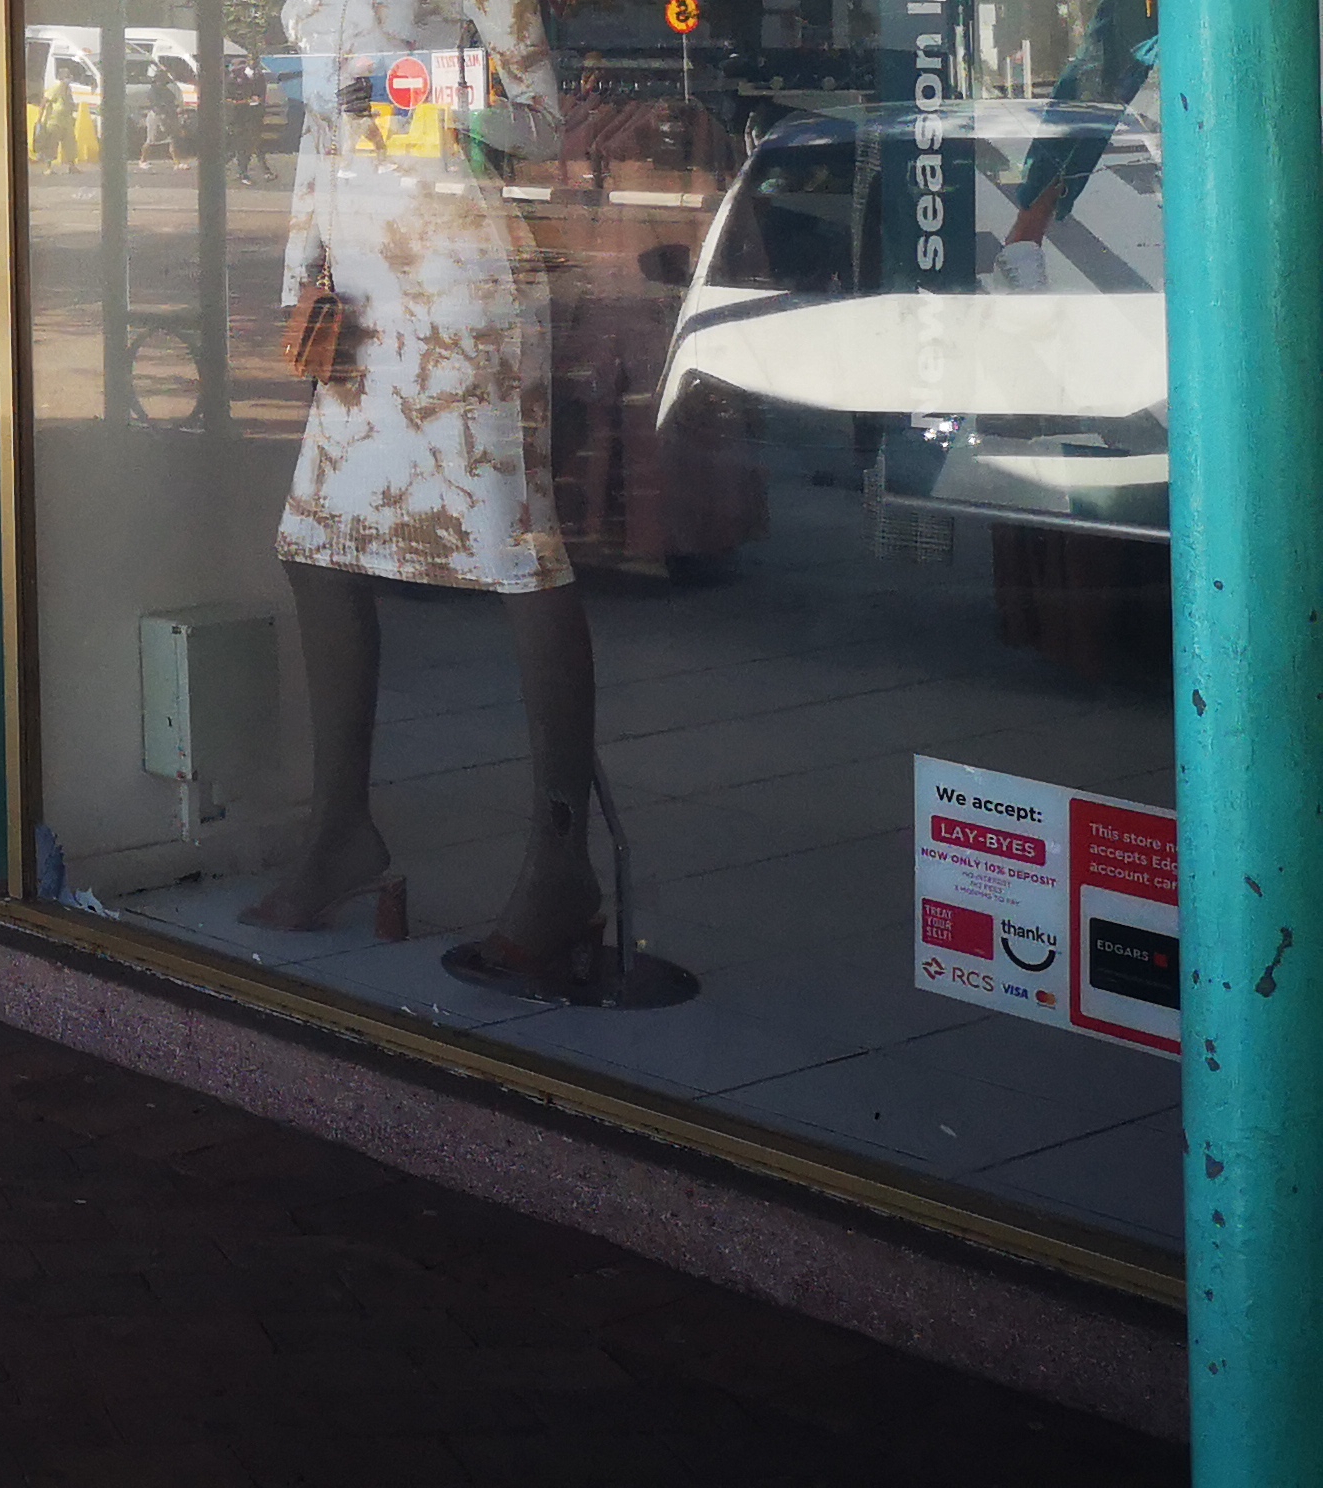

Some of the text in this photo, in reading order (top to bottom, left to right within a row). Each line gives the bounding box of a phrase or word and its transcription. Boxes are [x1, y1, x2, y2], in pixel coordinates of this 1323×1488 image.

[915, 33, 945, 272] season
[936, 785, 1042, 823] We accept:
[940, 823, 1036, 858] LAY-BYES
[1089, 823, 1119, 840] This
[1123, 832, 1161, 850] store
[921, 847, 1057, 888] NOW ONLY 10% DEPOSIT
[1089, 843, 1147, 865] accepts
[1152, 856, 1178, 875] Edg
[1089, 862, 1178, 891] account car
[924, 904, 953, 920] TREAT
[927, 916, 952, 931] YOUR
[1097, 939, 1150, 962] EDGARS
[952, 966, 995, 992] RCS
[1002, 982, 1029, 1000] VISA
